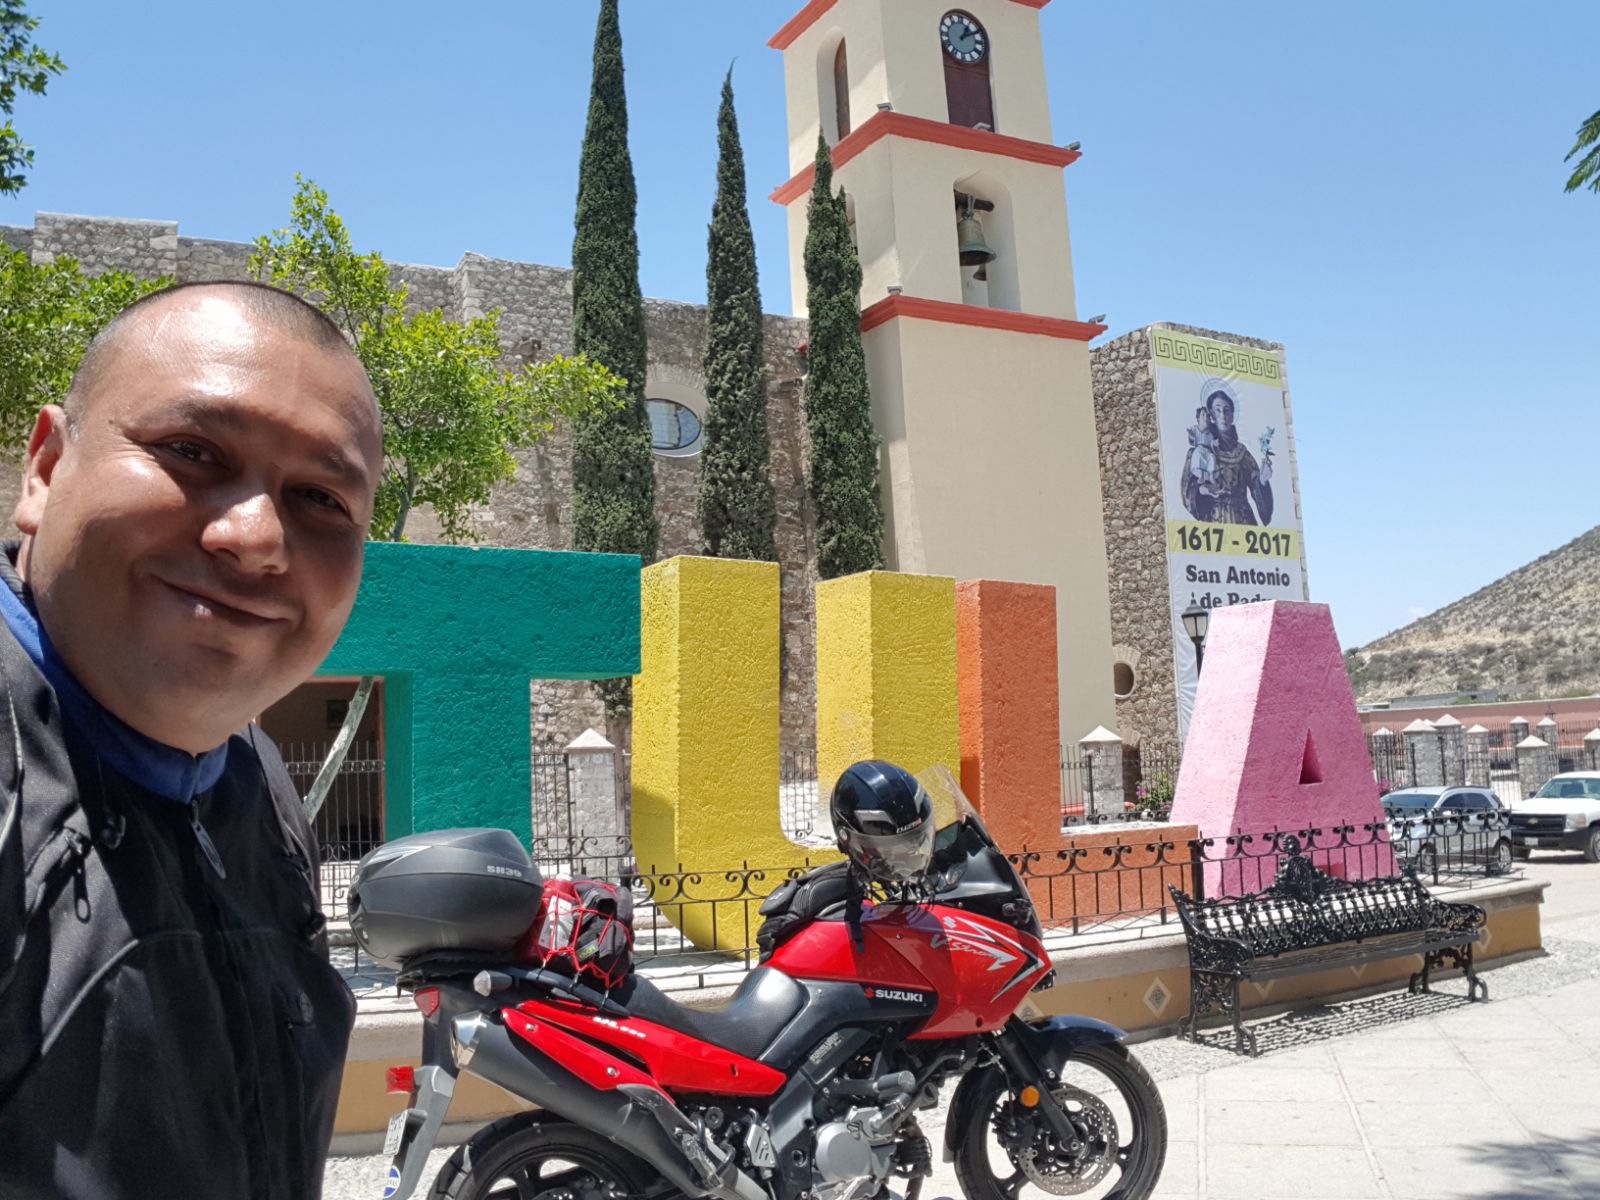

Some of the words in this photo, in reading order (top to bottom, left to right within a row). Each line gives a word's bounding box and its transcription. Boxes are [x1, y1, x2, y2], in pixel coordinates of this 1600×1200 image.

[1177, 525, 1224, 552] 1617
[1245, 530, 1291, 556] 2017
[1186, 564, 1221, 584] San
[1226, 566, 1290, 587] Antonio
[1200, 592, 1222, 609] de
[1227, 592, 1273, 606] Pad
[875, 989, 923, 1002] SUZUKI
